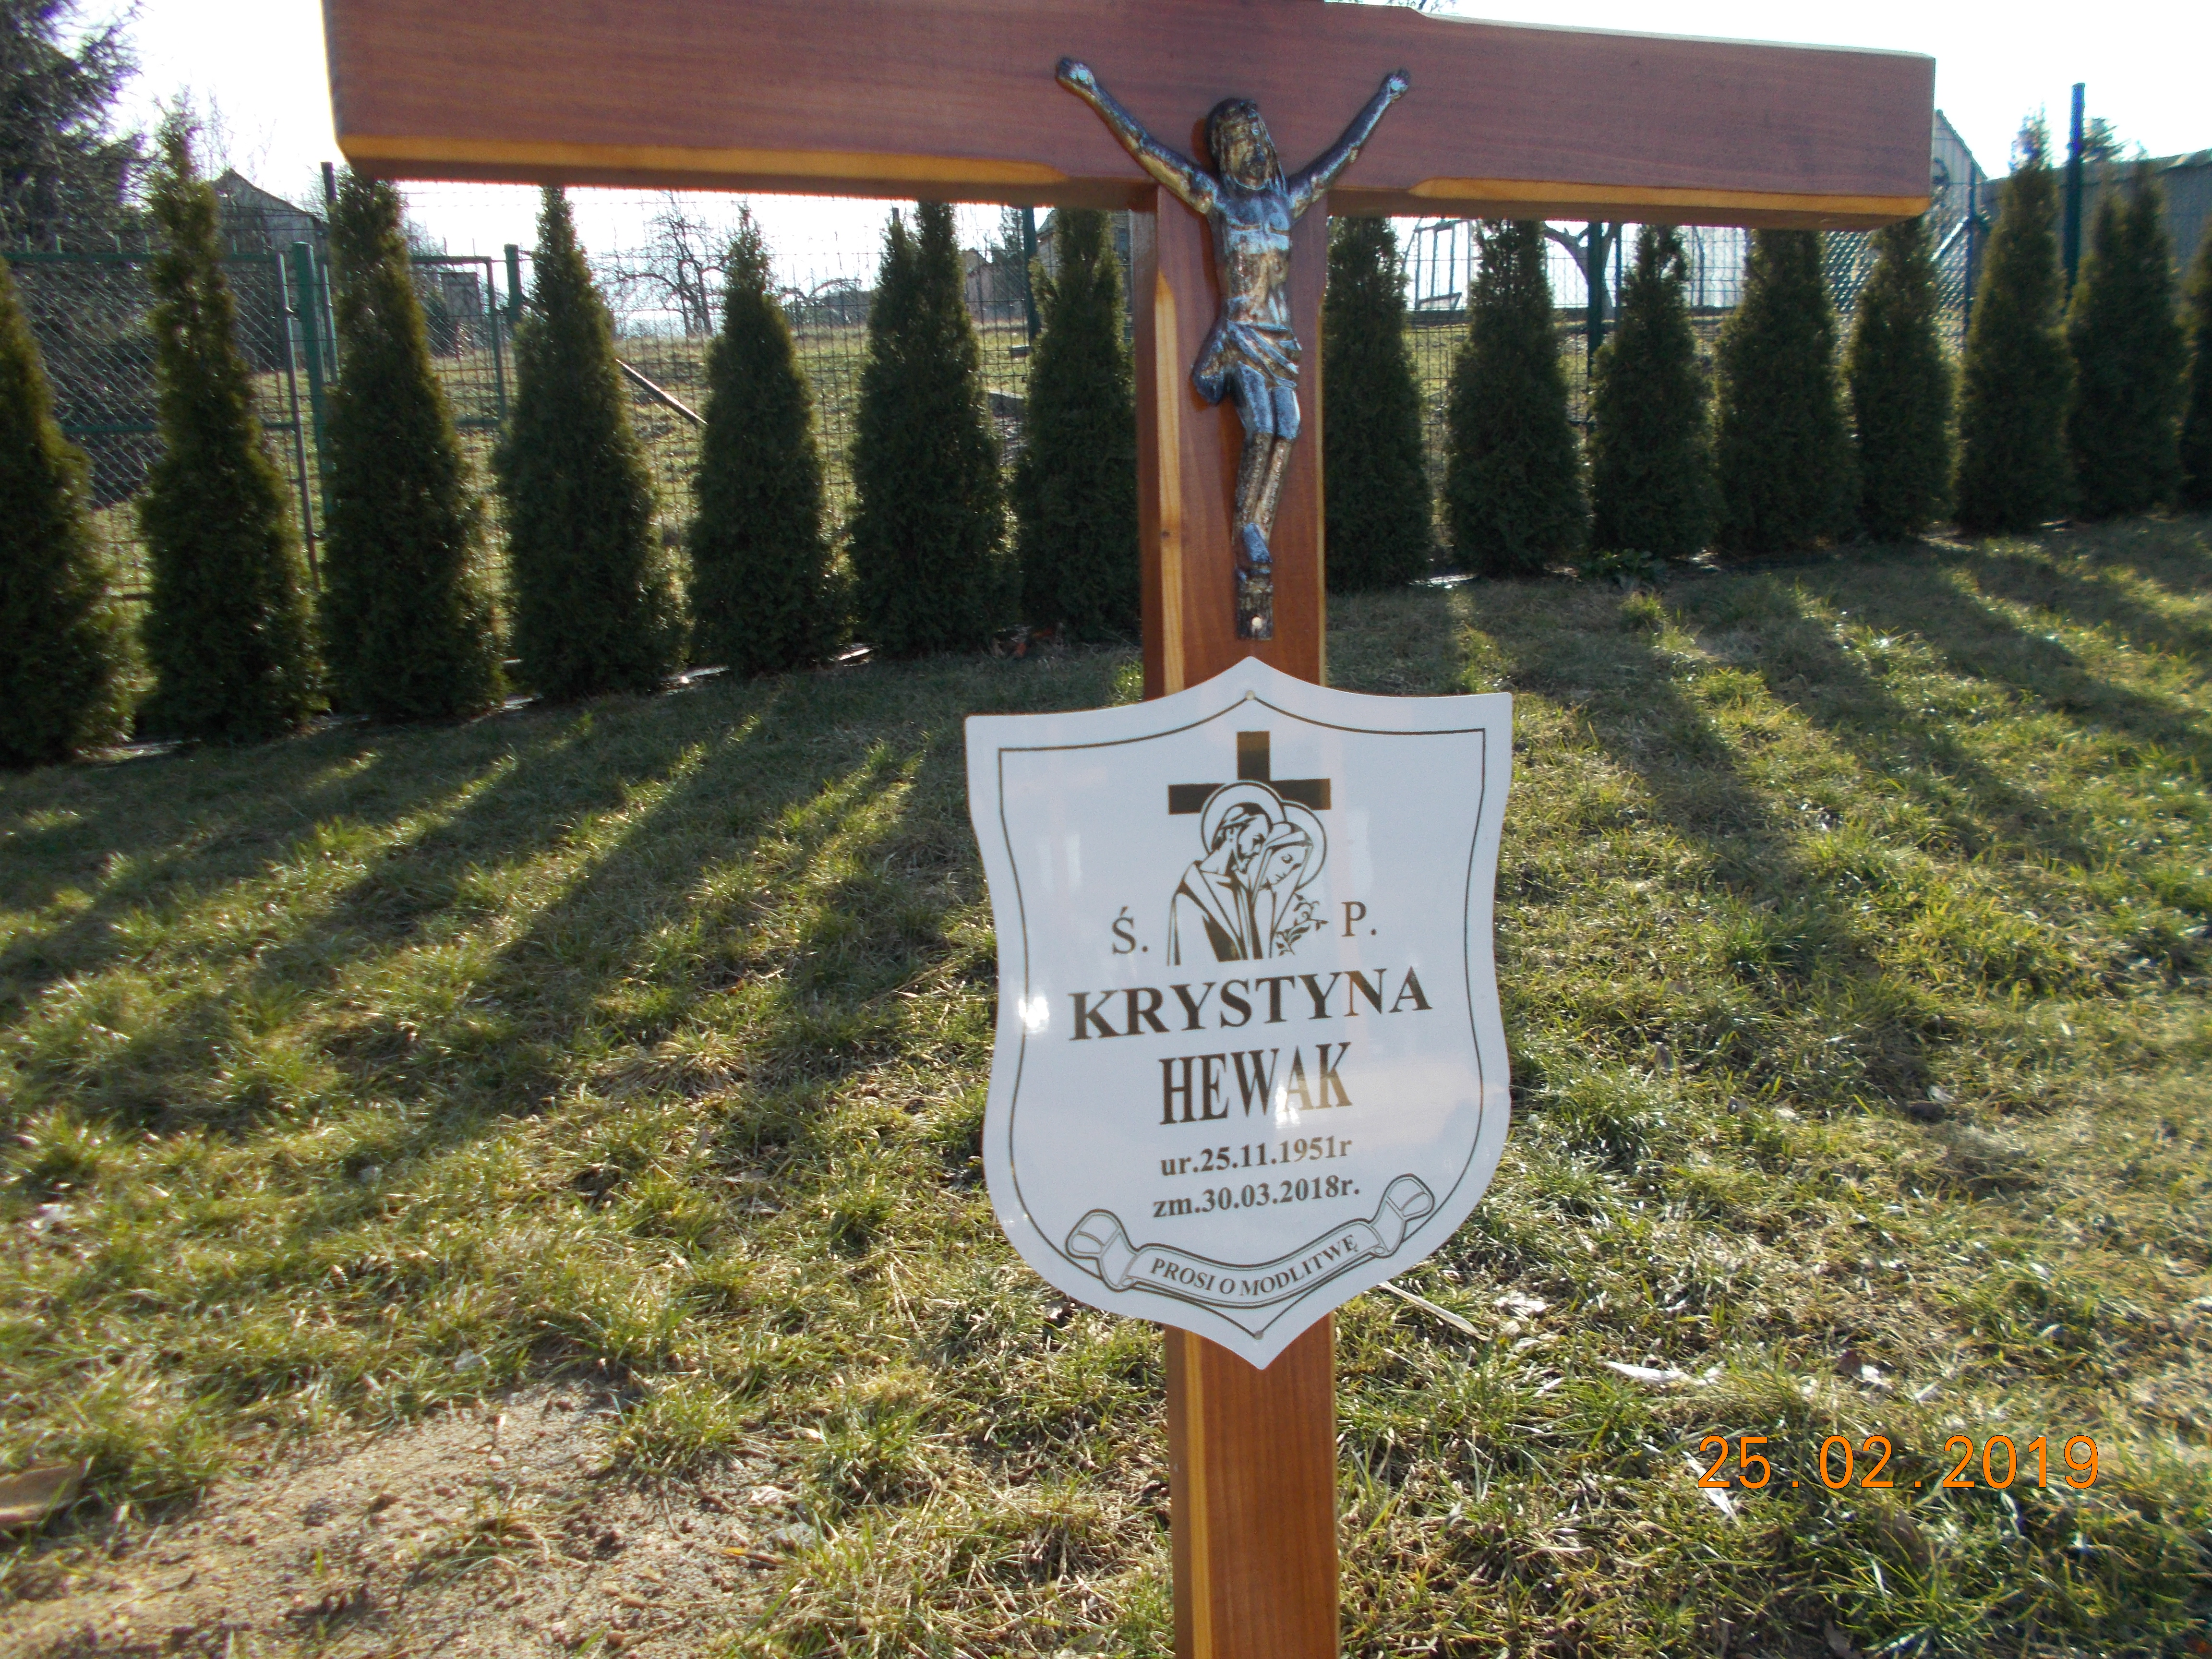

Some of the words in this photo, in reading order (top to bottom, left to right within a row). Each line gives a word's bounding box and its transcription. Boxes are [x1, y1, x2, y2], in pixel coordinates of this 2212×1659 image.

[1069, 966, 1432, 1041] KRYSTYNA
[1158, 1041, 1353, 1125] HEWAK
[1150, 1258, 1215, 1293] PROSI
[1219, 1277, 1236, 1294] O
[1239, 1234, 1358, 1297] MODLITWĘ
